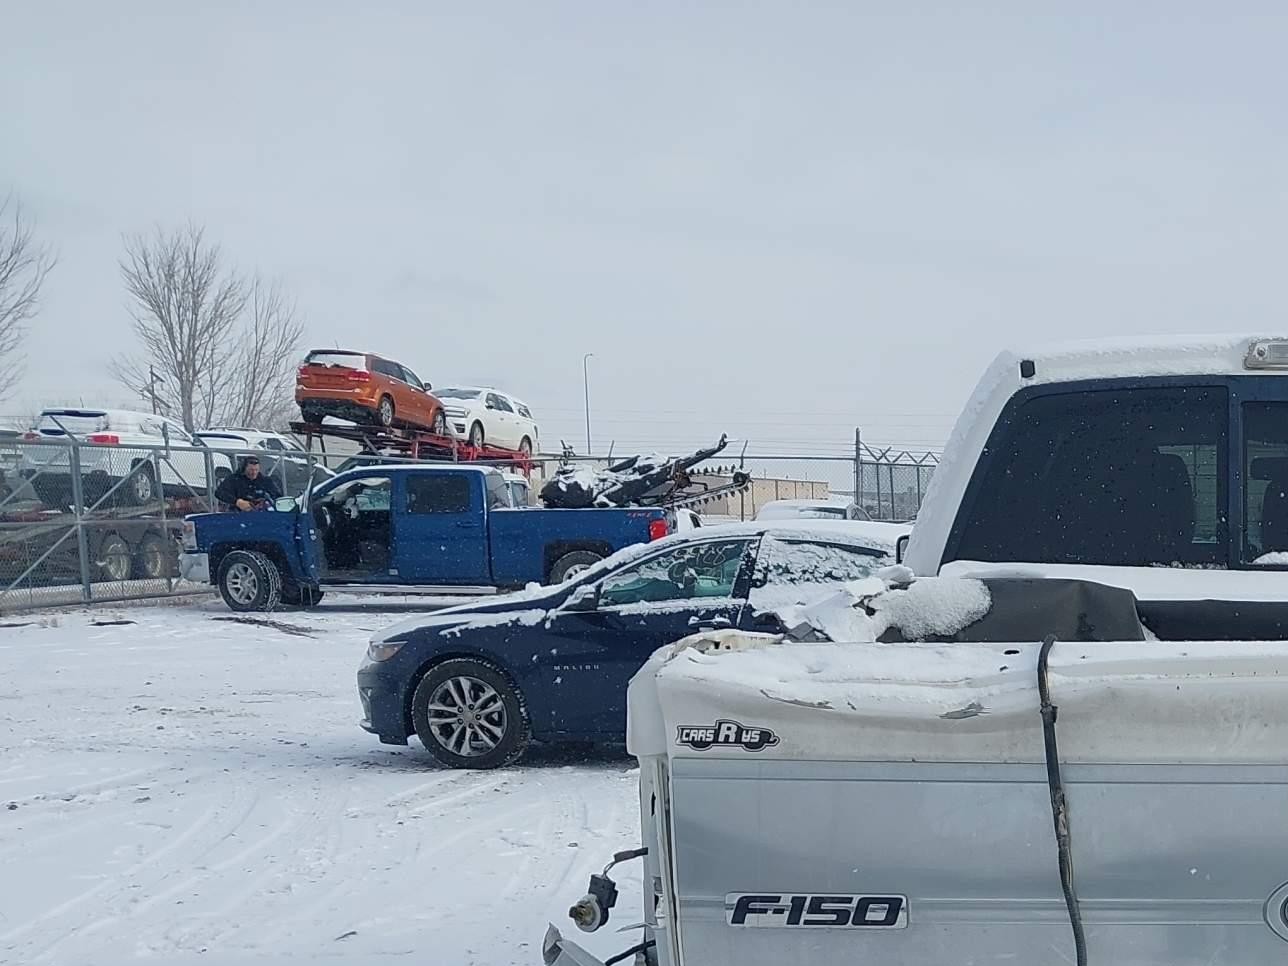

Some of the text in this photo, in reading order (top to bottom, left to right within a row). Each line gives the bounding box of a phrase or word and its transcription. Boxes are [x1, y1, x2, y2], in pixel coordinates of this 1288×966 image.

[682, 729, 715, 742] CARS
[718, 723, 738, 743] R
[730, 895, 904, 926] F-150
